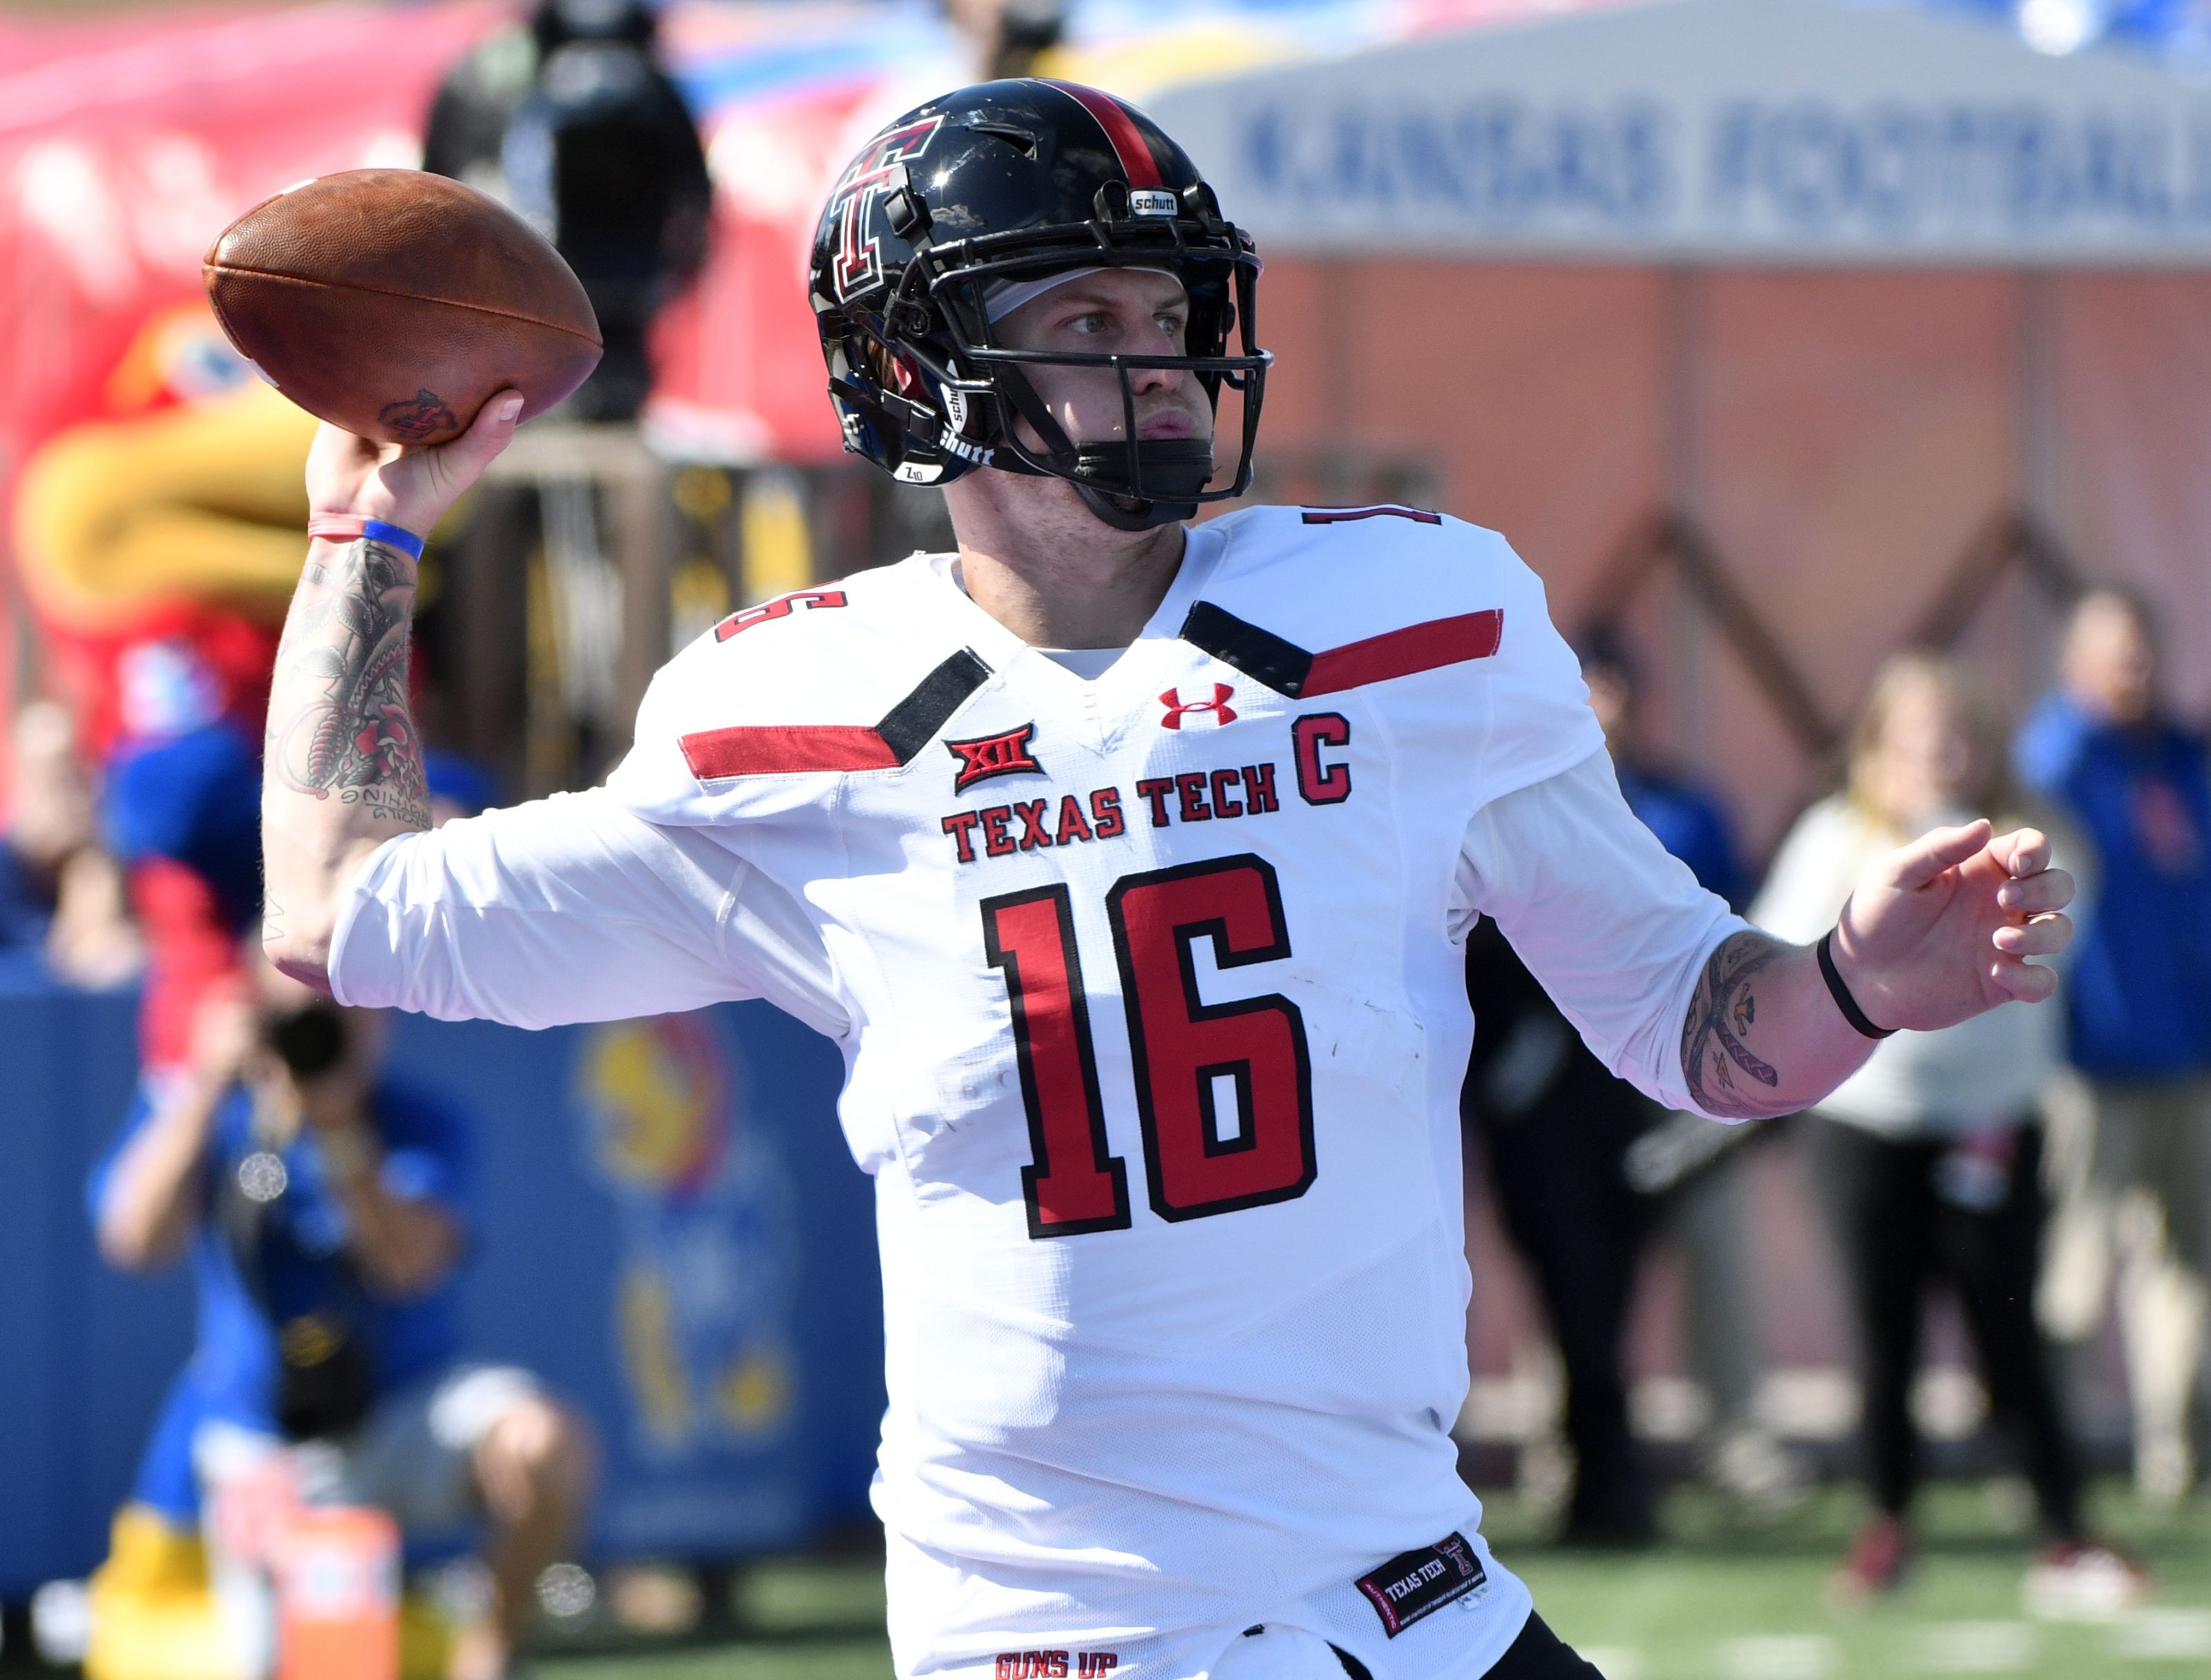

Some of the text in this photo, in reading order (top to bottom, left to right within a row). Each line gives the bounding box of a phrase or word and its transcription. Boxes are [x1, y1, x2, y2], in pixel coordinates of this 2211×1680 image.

[1135, 194, 1175, 211] schutt
[949, 388, 963, 422] schu
[1291, 711, 1351, 807] C
[941, 763, 1280, 864] TEXAS TECH
[980, 852, 1318, 1239] 16
[1385, 1572, 1423, 1603] TEXAS
[1418, 1558, 1447, 1583] TECH
[1365, 1583, 1397, 1630] AUTHENTIC
[996, 1650, 1118, 1680] GUNS UP
